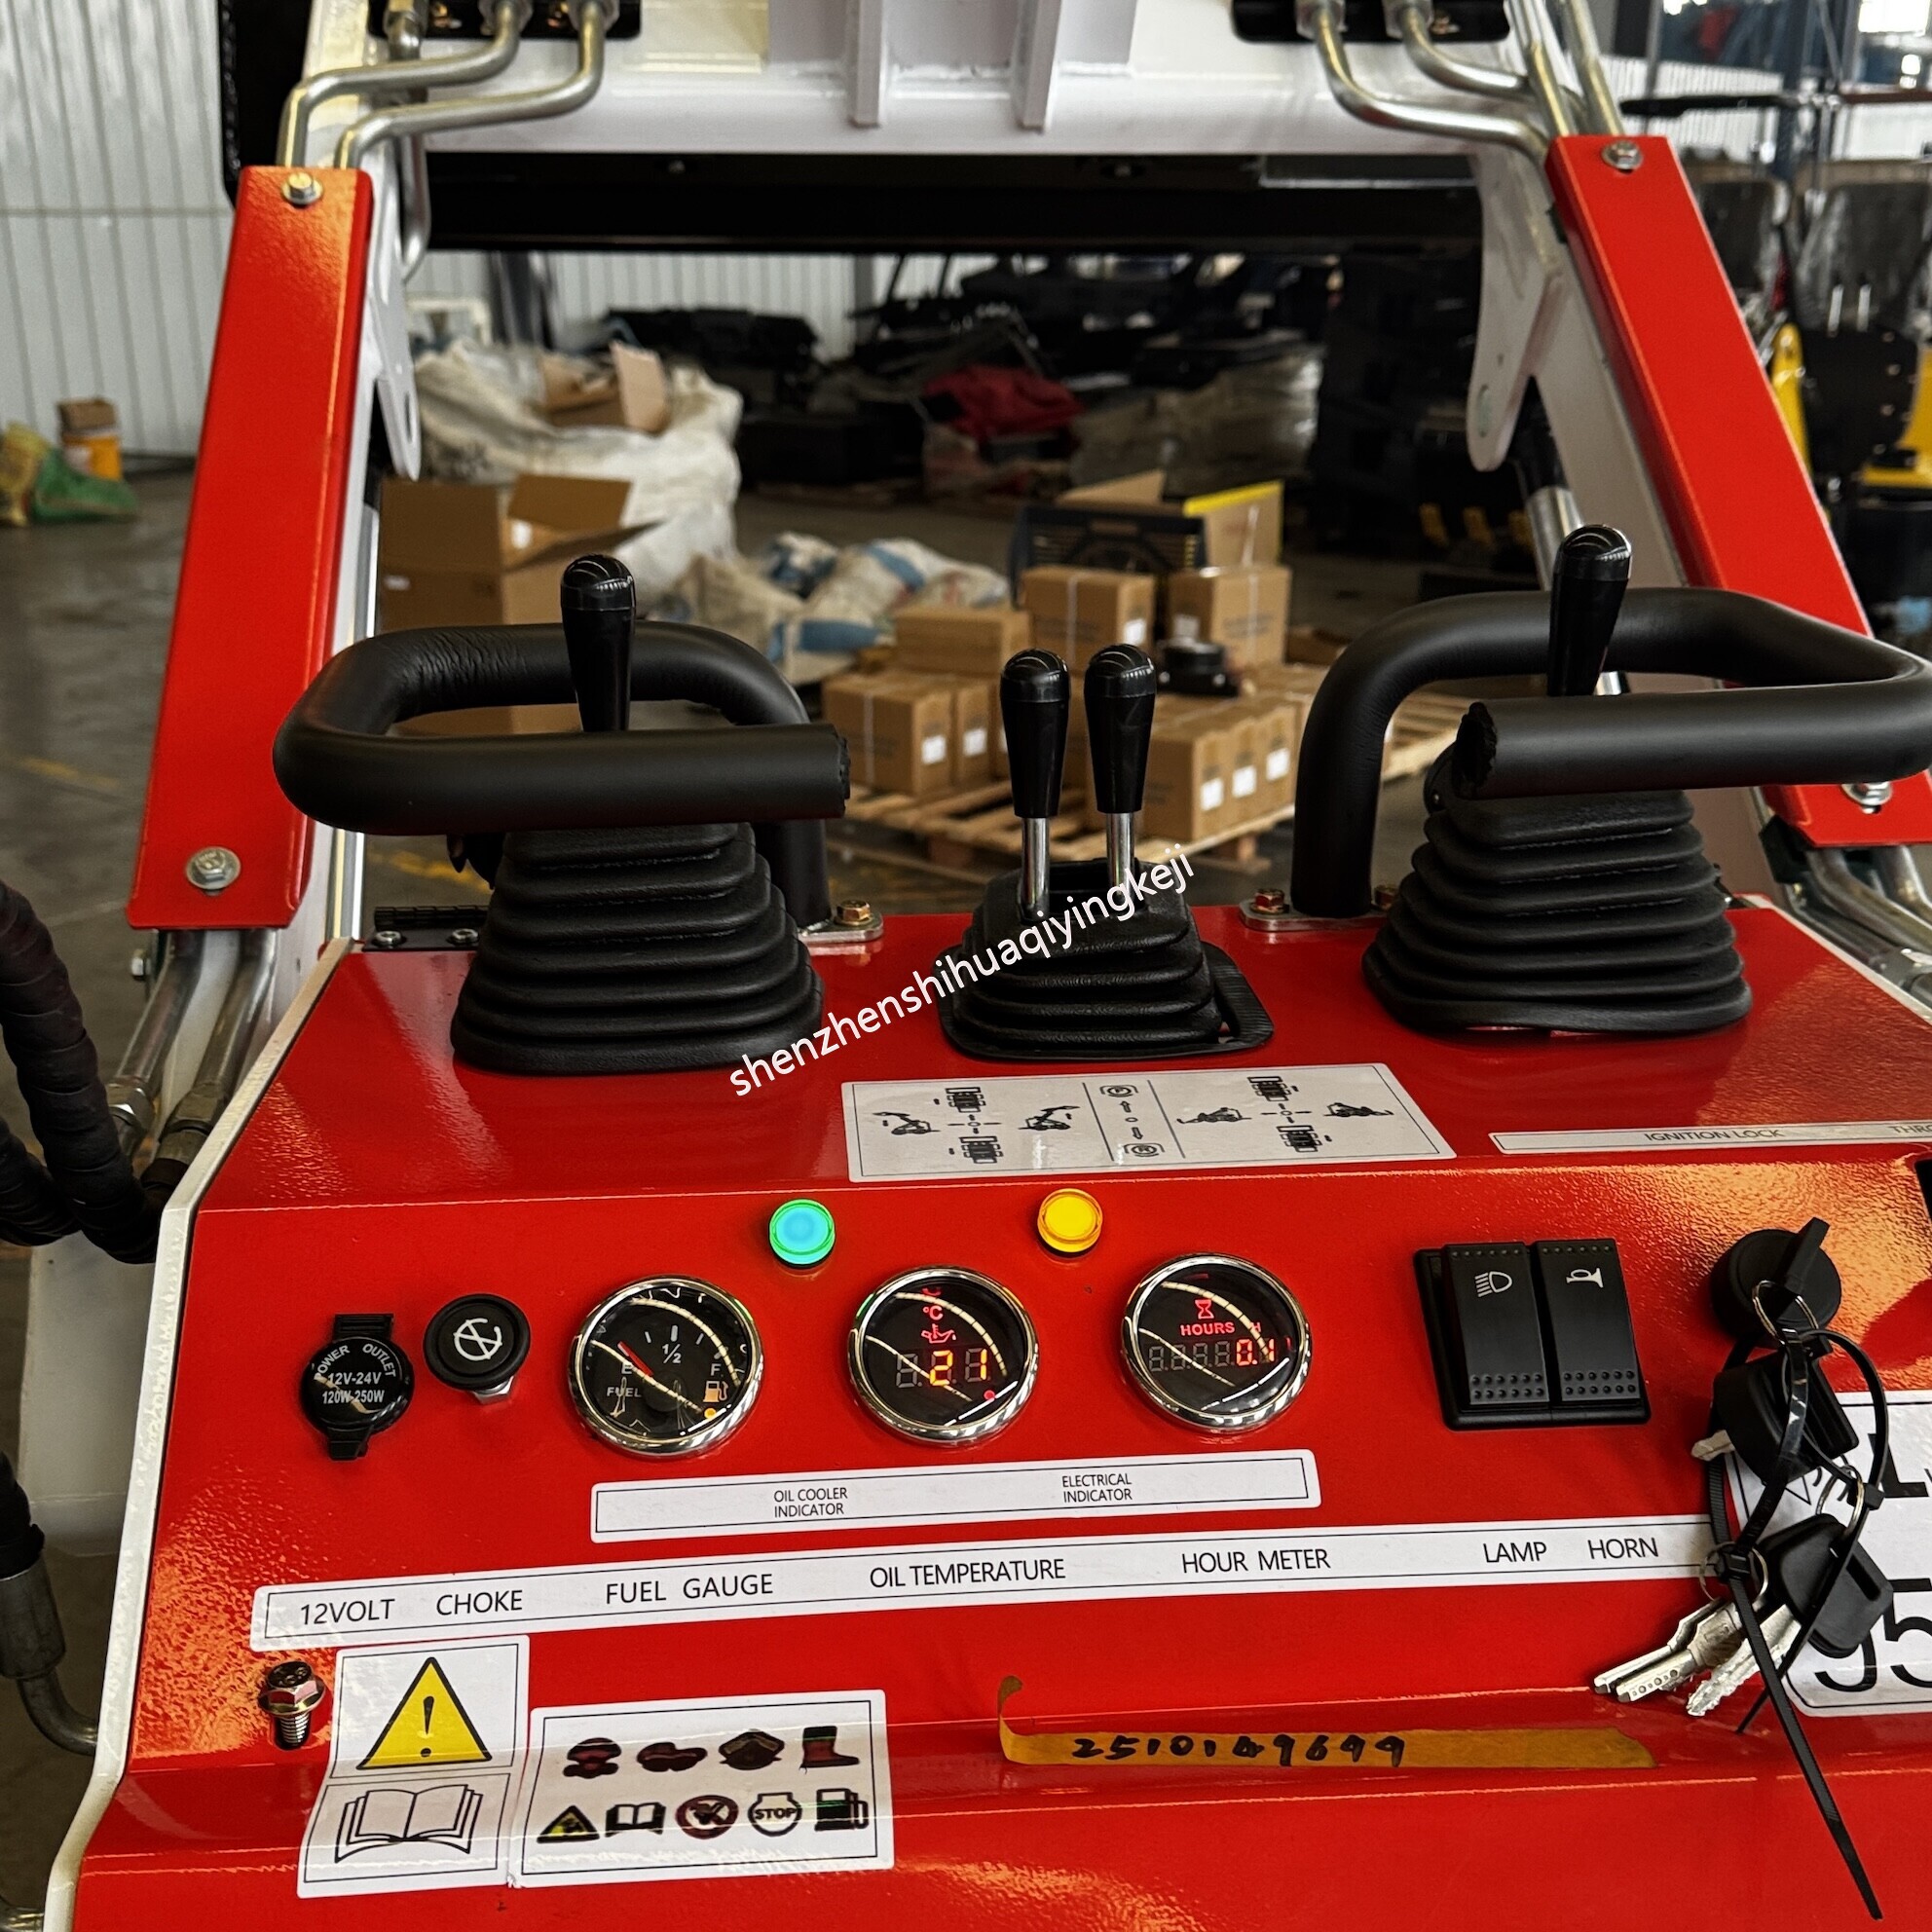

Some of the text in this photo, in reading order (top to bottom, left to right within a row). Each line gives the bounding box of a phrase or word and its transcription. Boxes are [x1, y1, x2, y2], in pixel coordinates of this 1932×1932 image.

[1644, 1127, 1786, 1142] IGNITION LOCK
[1179, 1321, 1236, 1337] HOURS
[314, 1343, 396, 1381] POWER OUTLET
[711, 1363, 722, 1377] F
[327, 1371, 382, 1386] 12V-24V
[322, 1390, 386, 1404] 120W-250W
[607, 1386, 643, 1398] FUEL
[1061, 1473, 1133, 1488] ELECTRICAL
[773, 1487, 848, 1504] OIL COOLER
[1062, 1487, 1133, 1504] INDICATOR
[774, 1503, 844, 1518] INDICATOR
[1482, 1542, 1547, 1563] LAMP
[1587, 1537, 1659, 1560] HORN
[1181, 1548, 1331, 1575] HOUR METER
[870, 1558, 1066, 1588] OIL TEMPERATURE
[605, 1574, 774, 1605] FUEL GAUGE
[300, 1597, 395, 1625] 12VOLT
[435, 1589, 524, 1616] CHOKE
[755, 1807, 798, 1820] STOP
